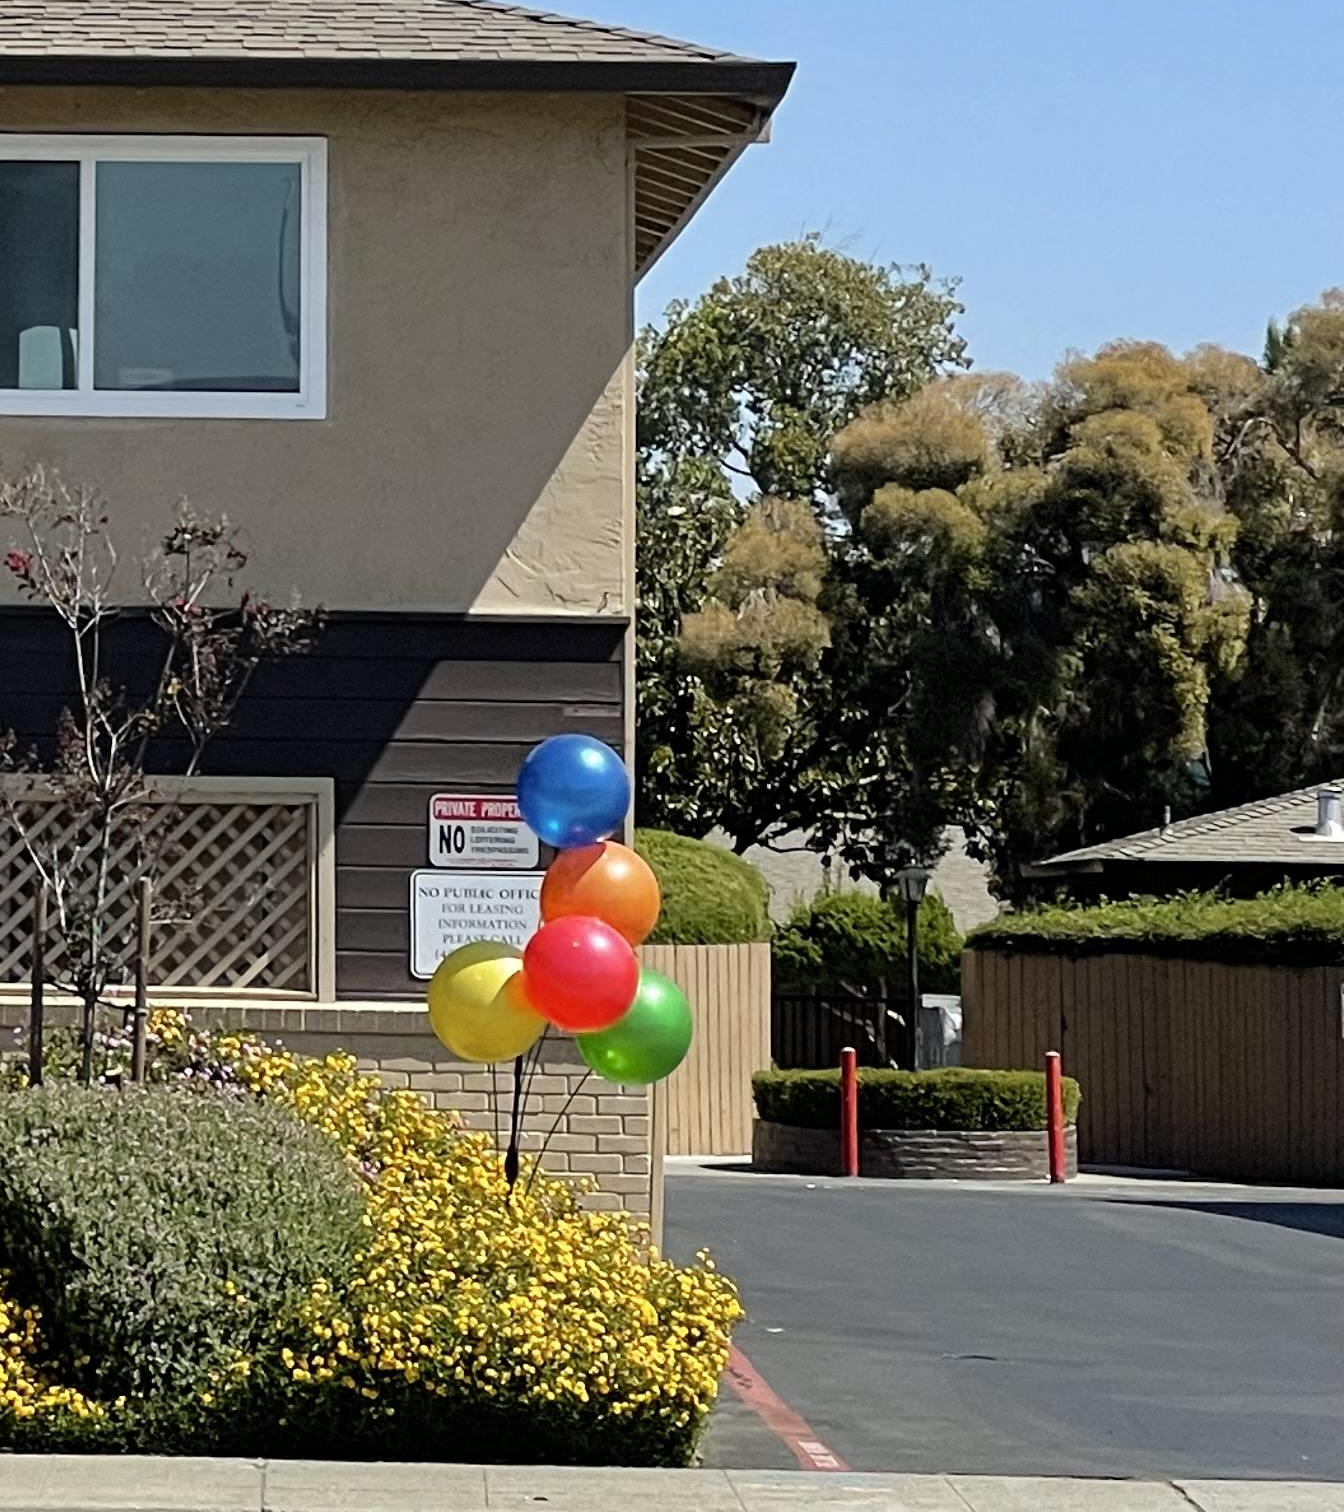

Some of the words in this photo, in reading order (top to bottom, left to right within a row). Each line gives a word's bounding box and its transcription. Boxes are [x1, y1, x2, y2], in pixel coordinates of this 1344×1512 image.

[434, 800, 477, 817] PRIVATE
[439, 825, 465, 854] NO
[419, 888, 440, 898] NO
[443, 888, 494, 899] PUBLIC
[499, 889, 538, 899] OFFIC
[441, 903, 466, 913] FOR
[470, 904, 523, 914] LEASING
[438, 919, 527, 929] INFORMATION
